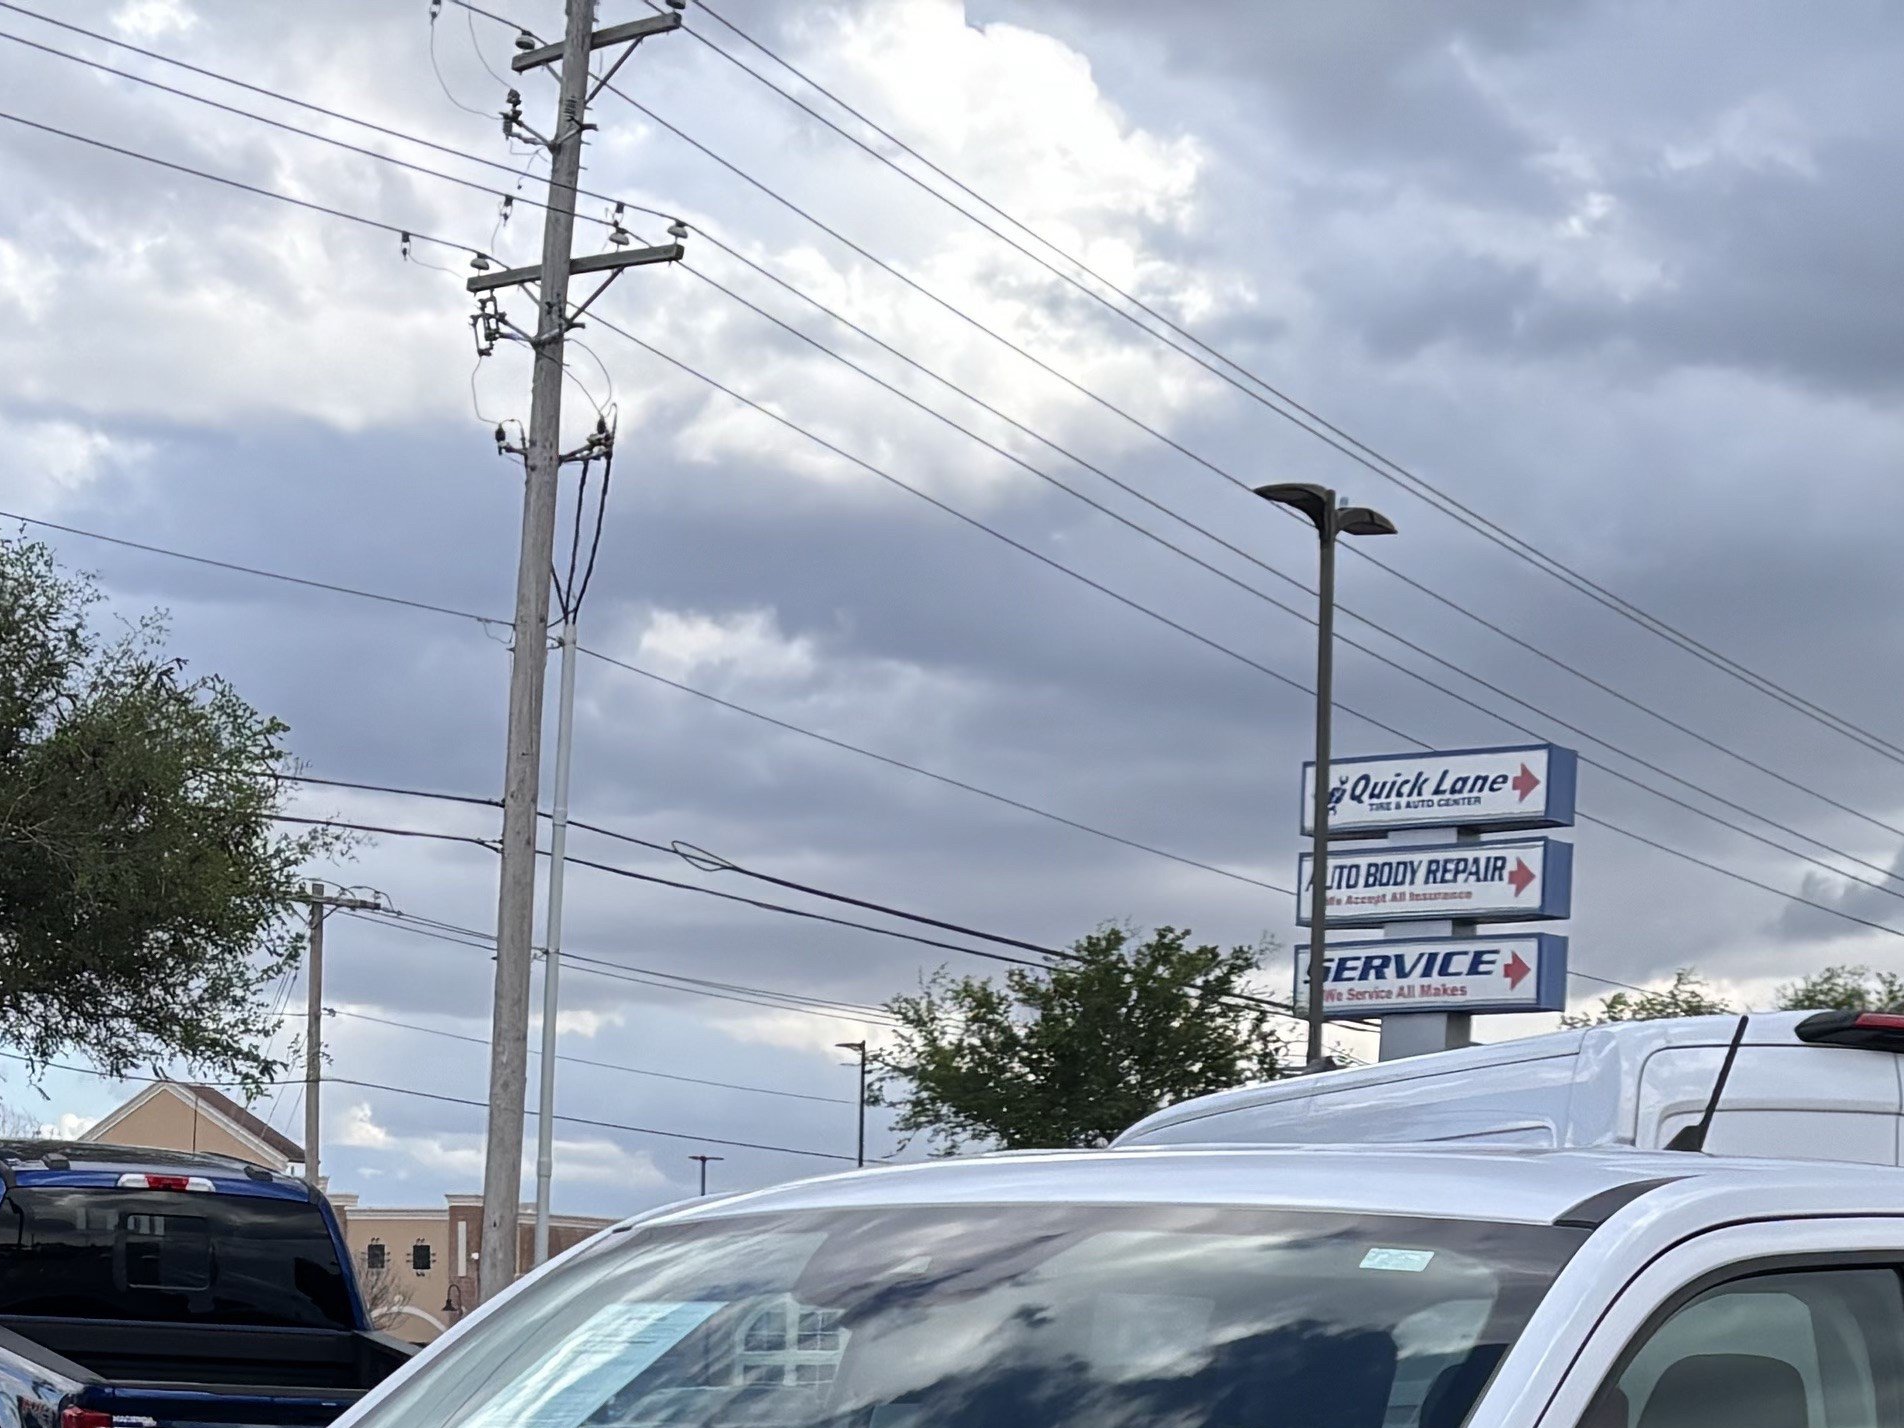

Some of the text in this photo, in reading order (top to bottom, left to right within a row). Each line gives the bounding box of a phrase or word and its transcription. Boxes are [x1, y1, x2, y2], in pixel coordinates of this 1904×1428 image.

[1350, 768, 1509, 804] Quick Lane
[1369, 801, 1392, 811] TIRE
[1405, 799, 1435, 810] AUTO
[1437, 796, 1482, 808] CENTER
[1305, 855, 1507, 892] UTO BODY REPAIR
[1345, 893, 1387, 906] Accept
[1391, 891, 1406, 903] All
[1409, 890, 1473, 902] Insurance
[1323, 983, 1468, 1002] We Service All Makes
